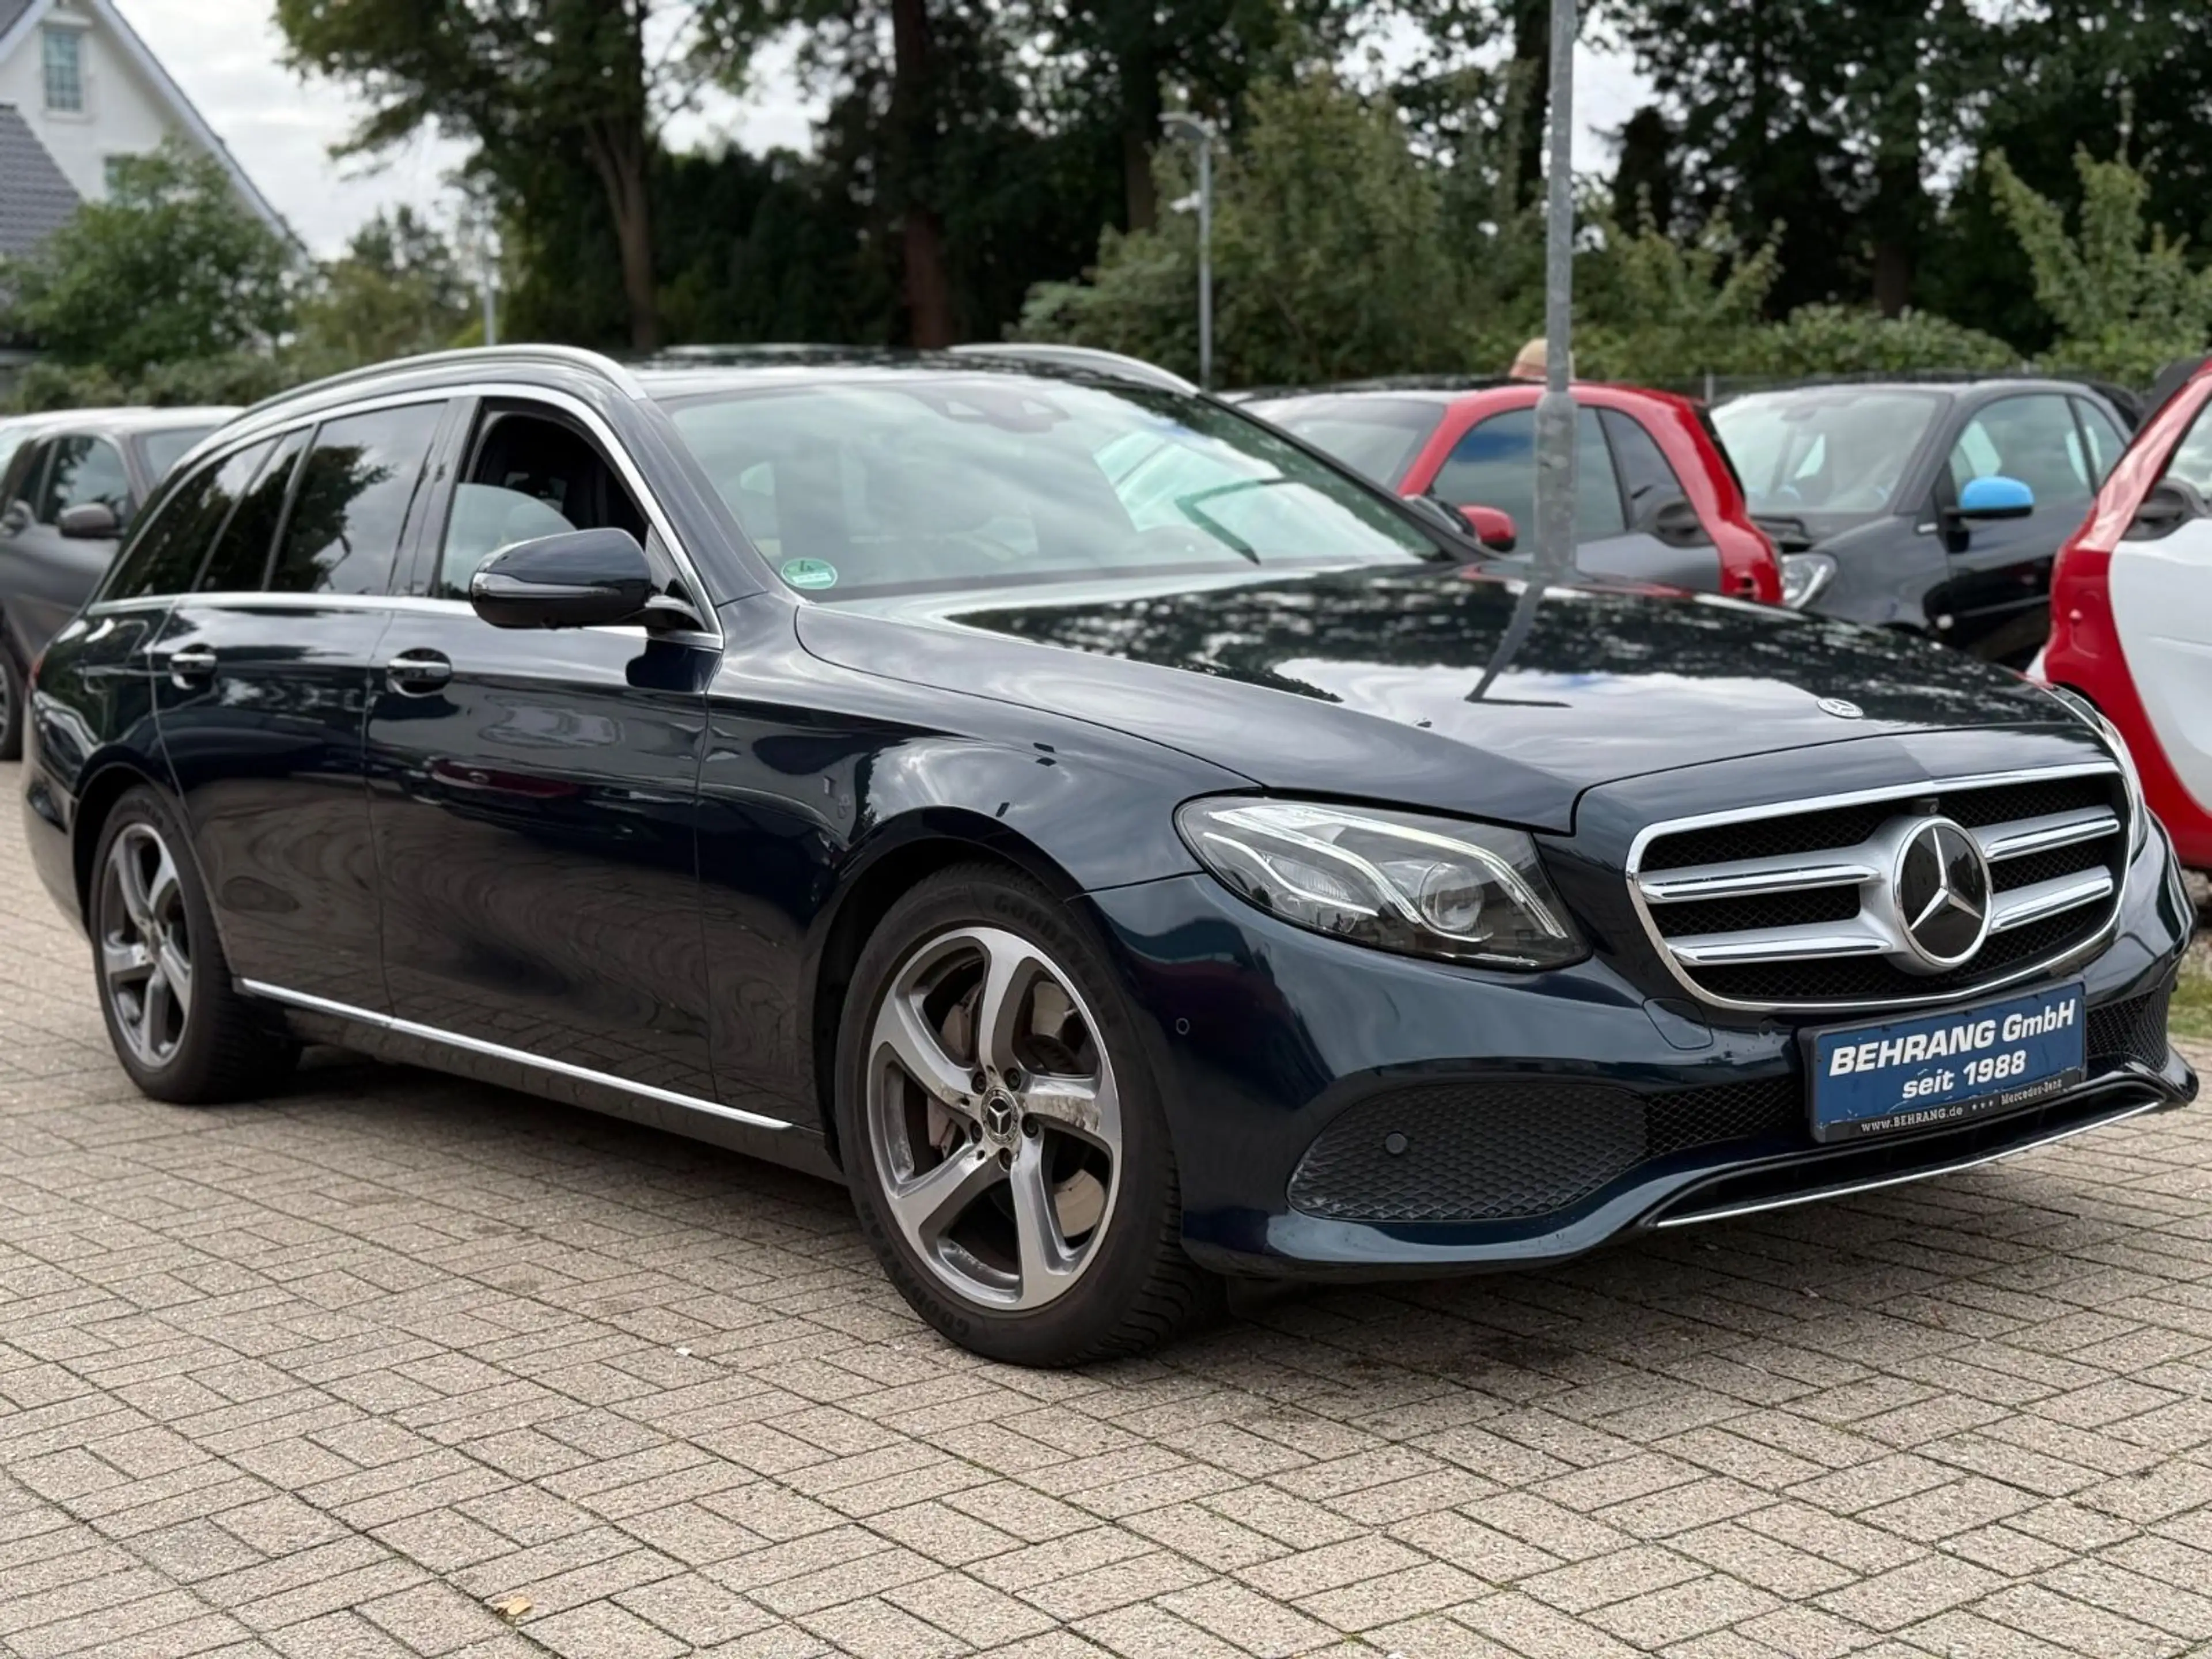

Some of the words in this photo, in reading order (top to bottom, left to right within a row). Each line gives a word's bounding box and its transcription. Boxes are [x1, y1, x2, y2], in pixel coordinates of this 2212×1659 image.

[1828, 1020, 1996, 1077] BEHRANG
[2002, 998, 2076, 1042] GmbH
[1902, 1071, 1955, 1099] seit
[1963, 1050, 2027, 1086] 1988
[1861, 1106, 1963, 1132] www.BEHRANG.de
